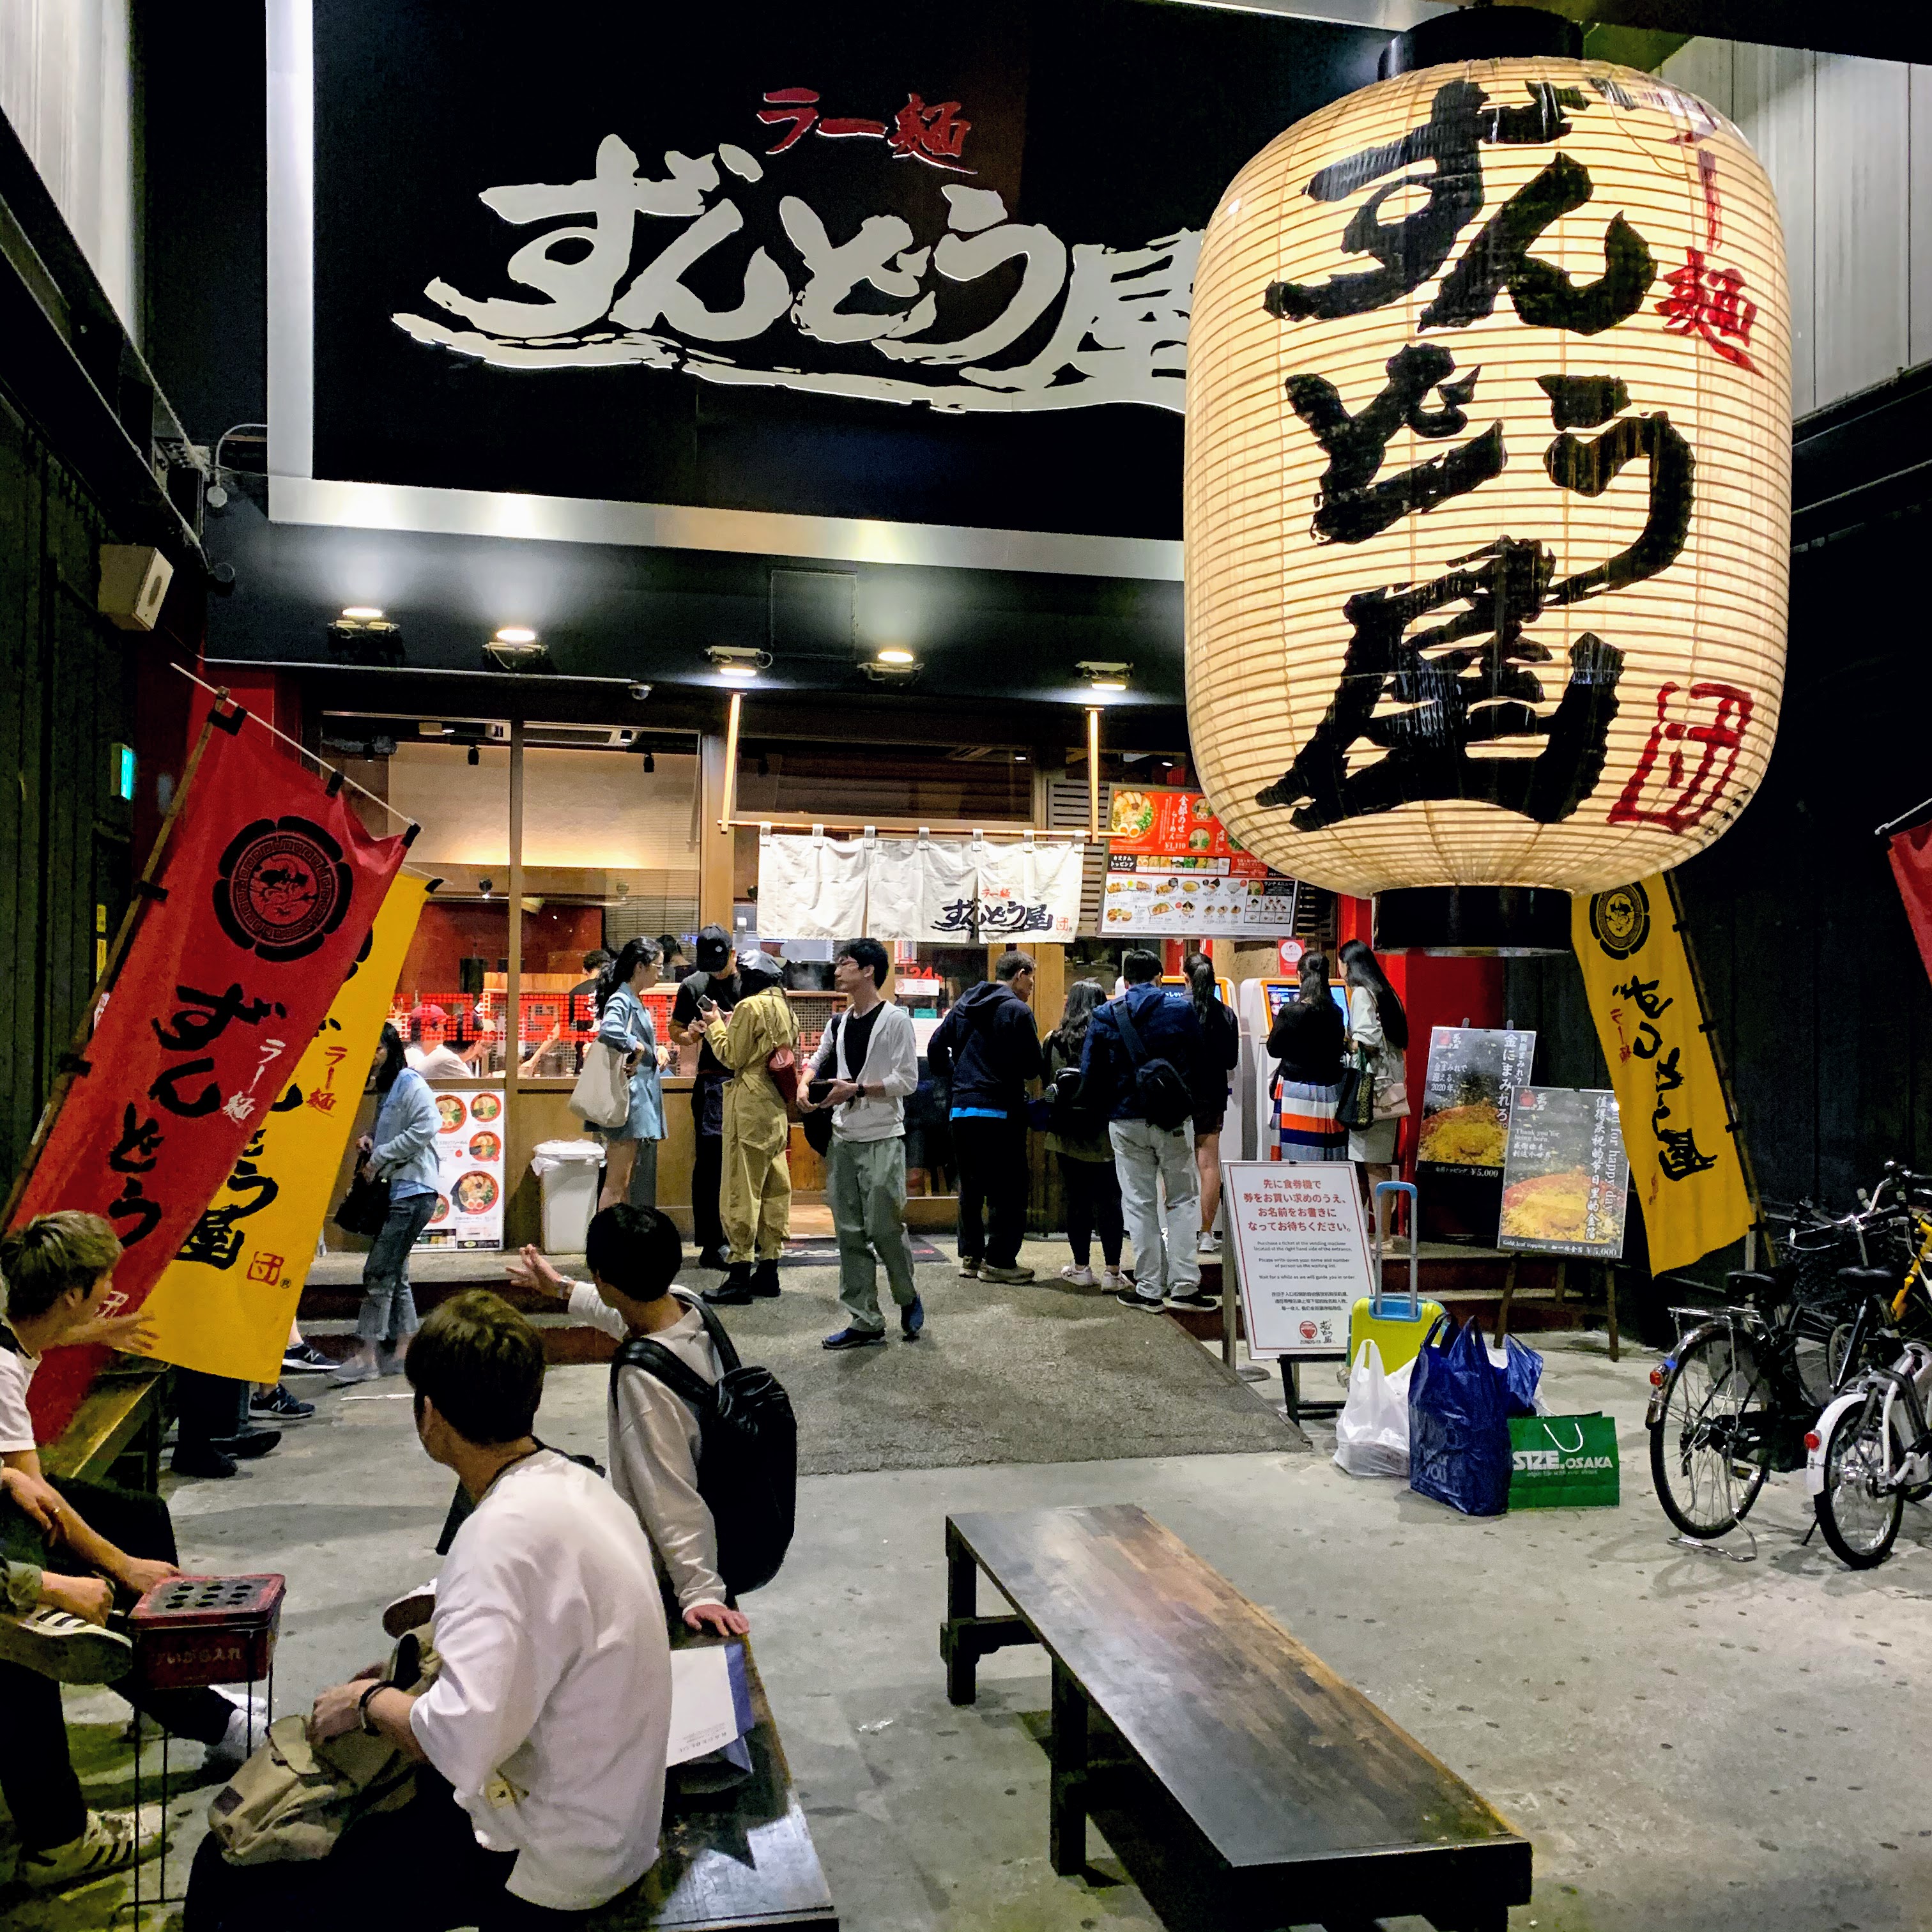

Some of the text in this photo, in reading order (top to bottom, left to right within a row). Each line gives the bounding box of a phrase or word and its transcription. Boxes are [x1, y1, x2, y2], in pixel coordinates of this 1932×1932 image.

[1609, 1128, 1622, 1146] for
[1604, 1150, 1621, 1186] happy
[1263, 1179, 1321, 1189] 先に食券機で
[1258, 1208, 1337, 1217] お名前をお書きに
[1248, 1221, 1351, 1232] なってお待ちください。
